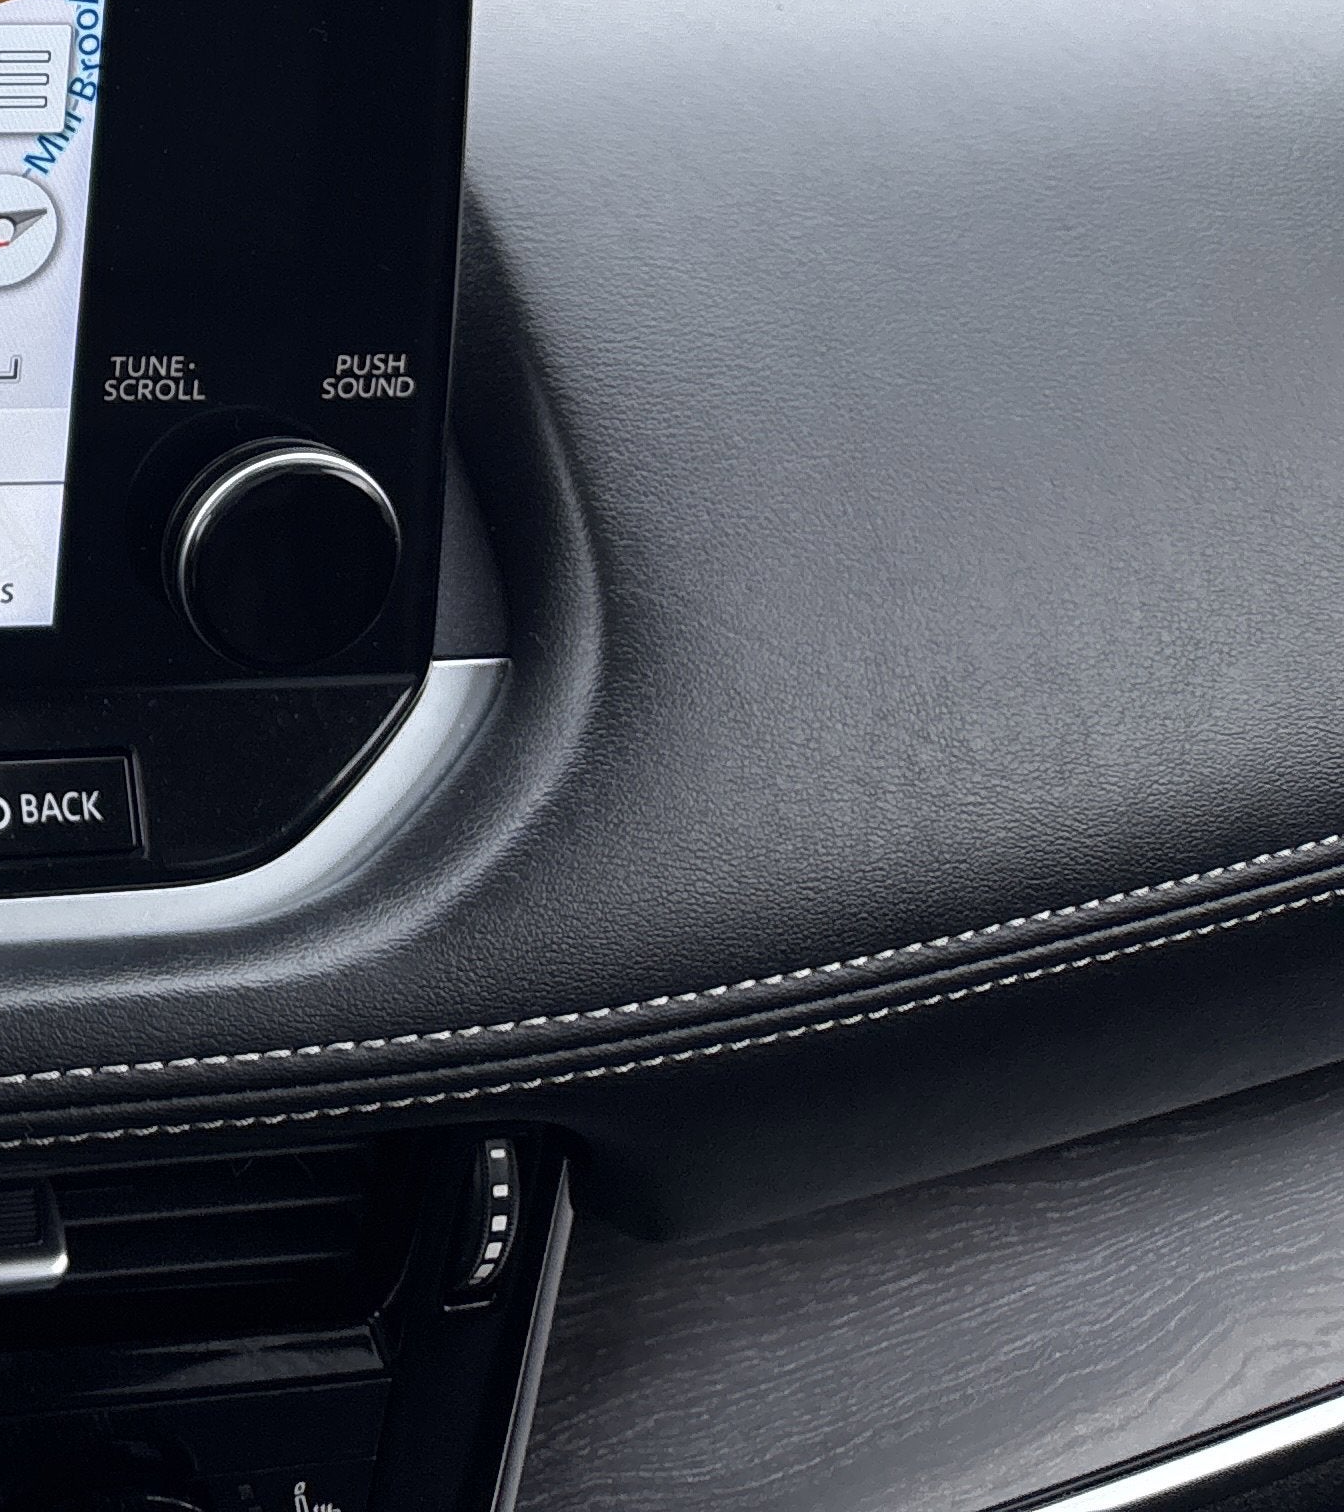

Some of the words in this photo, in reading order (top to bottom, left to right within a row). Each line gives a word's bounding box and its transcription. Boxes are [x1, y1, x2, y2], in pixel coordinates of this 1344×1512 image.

[335, 353, 407, 376] PUSH
[103, 378, 206, 402] SCROLL
[321, 376, 415, 400] SOUND
[20, 790, 104, 824] BACK
